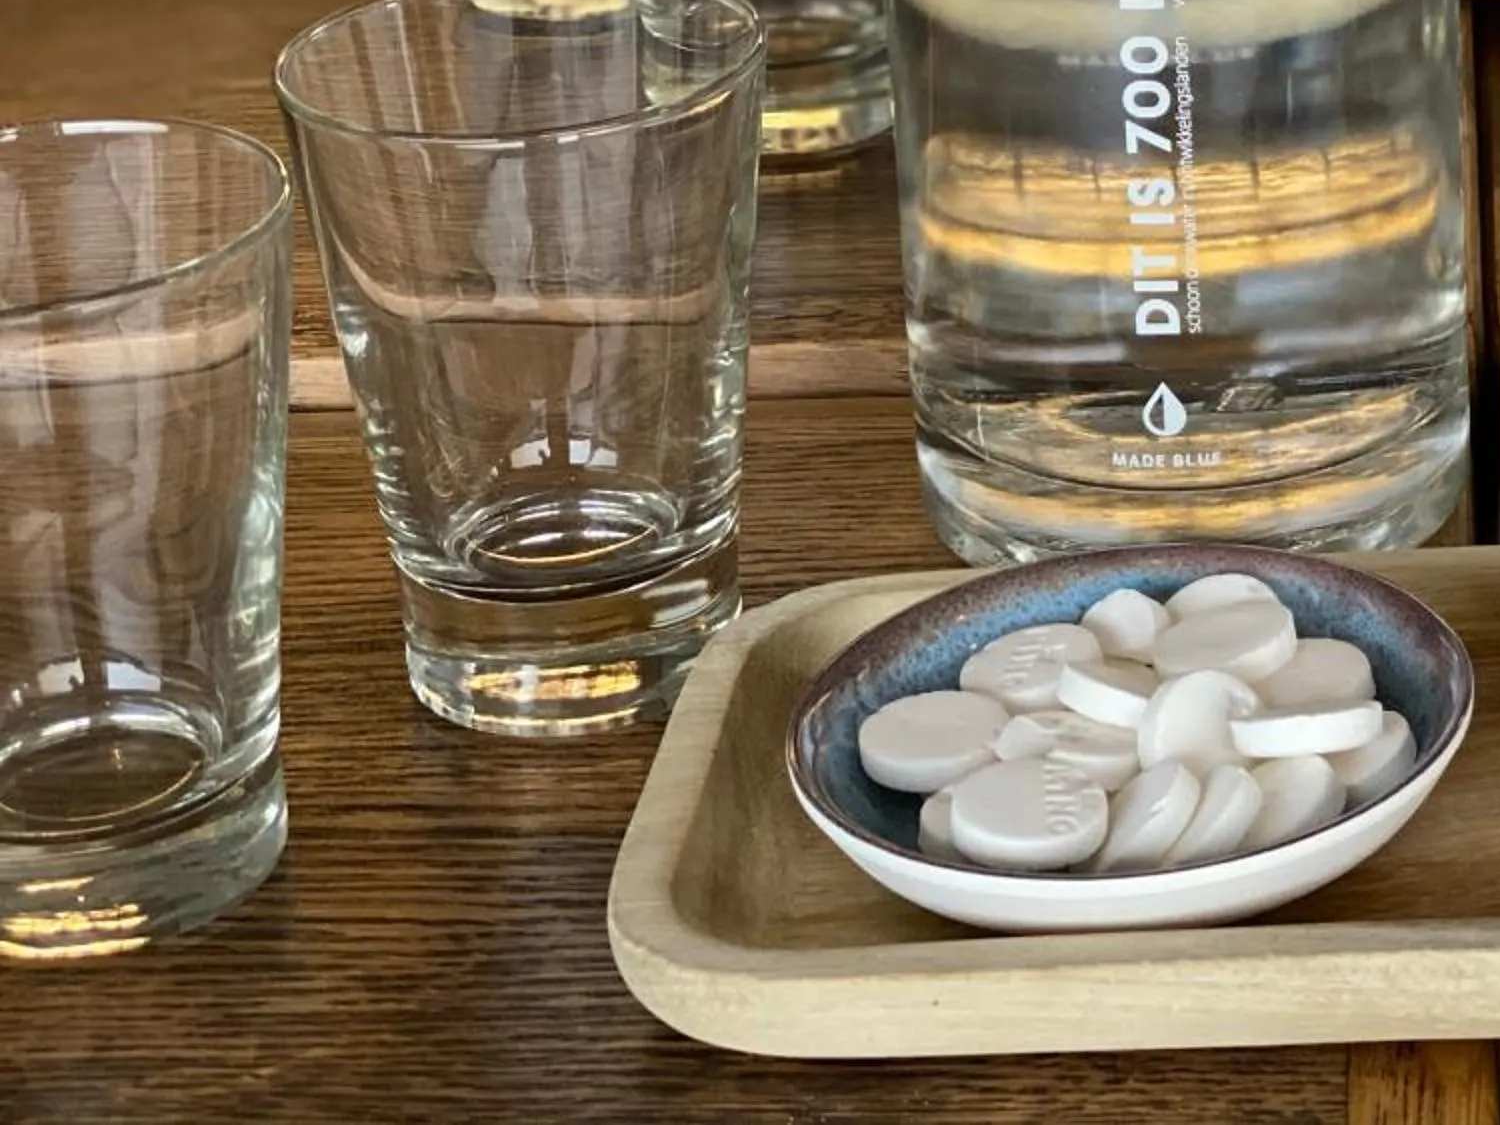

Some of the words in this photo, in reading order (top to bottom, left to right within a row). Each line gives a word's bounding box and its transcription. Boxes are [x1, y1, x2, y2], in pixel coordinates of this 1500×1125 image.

[1119, 35, 1173, 154] 700
[1126, 178, 1176, 225] IS
[1129, 244, 1182, 335] DIT
[1185, 280, 1201, 334] schoon
[1112, 452, 1165, 469] MADE
[1172, 451, 1221, 469] BLUE
